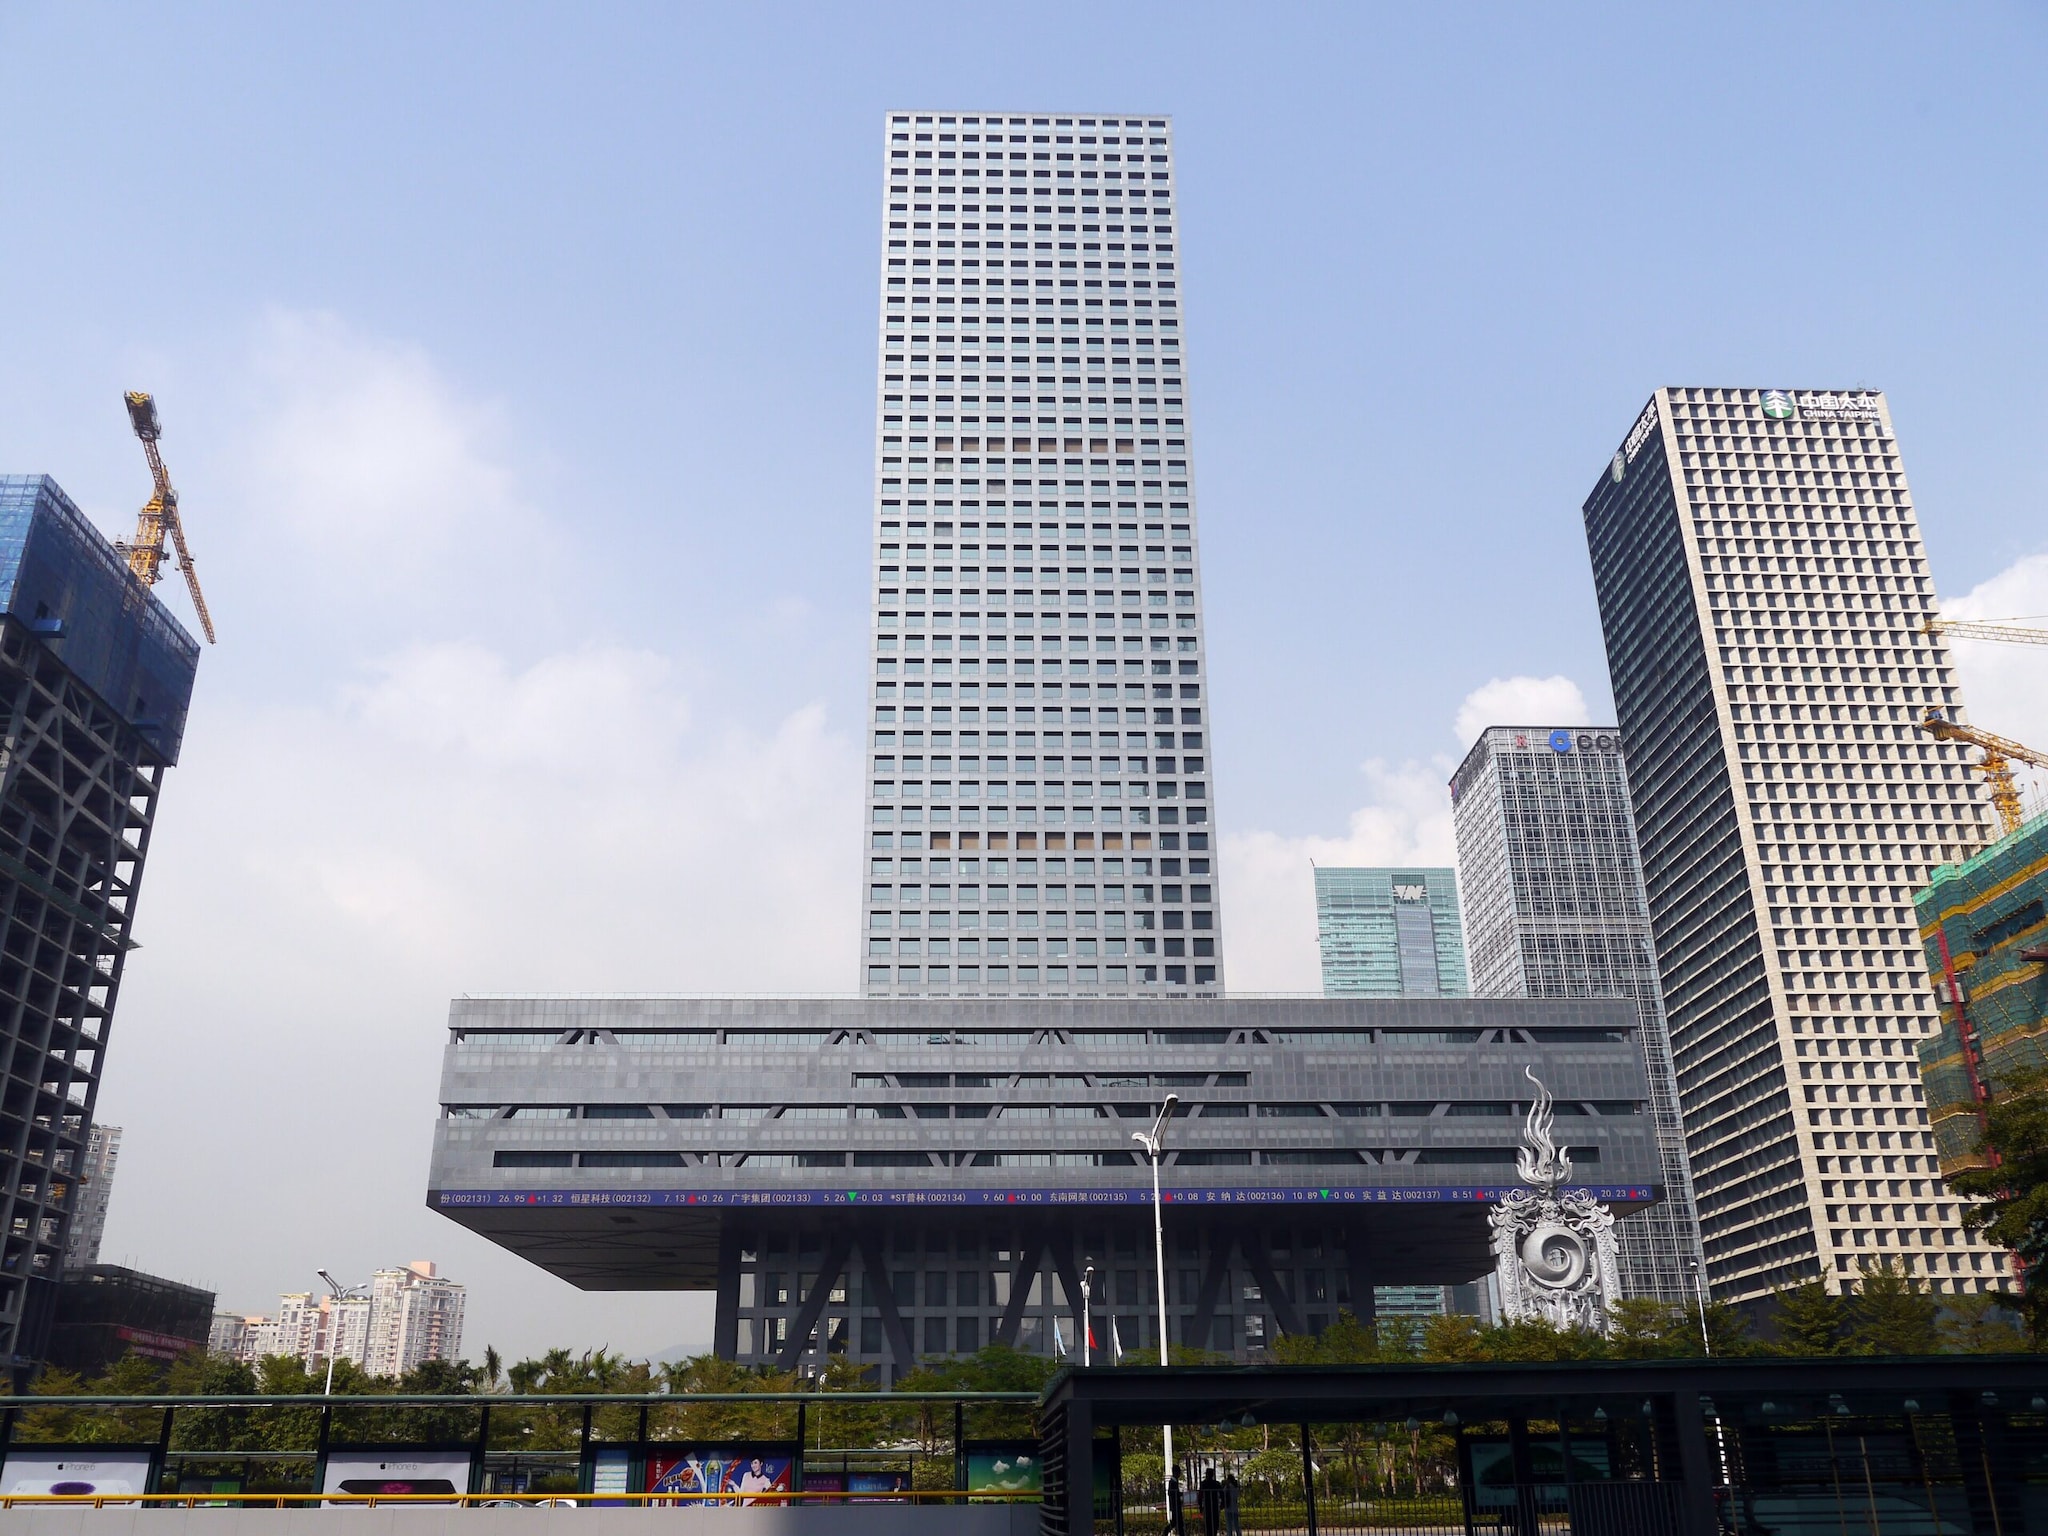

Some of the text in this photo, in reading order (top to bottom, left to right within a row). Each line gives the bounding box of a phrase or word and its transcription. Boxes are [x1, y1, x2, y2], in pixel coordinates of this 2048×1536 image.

[1800, 395, 1877, 410] 中国太平
[1803, 410, 1836, 418] CHINA
